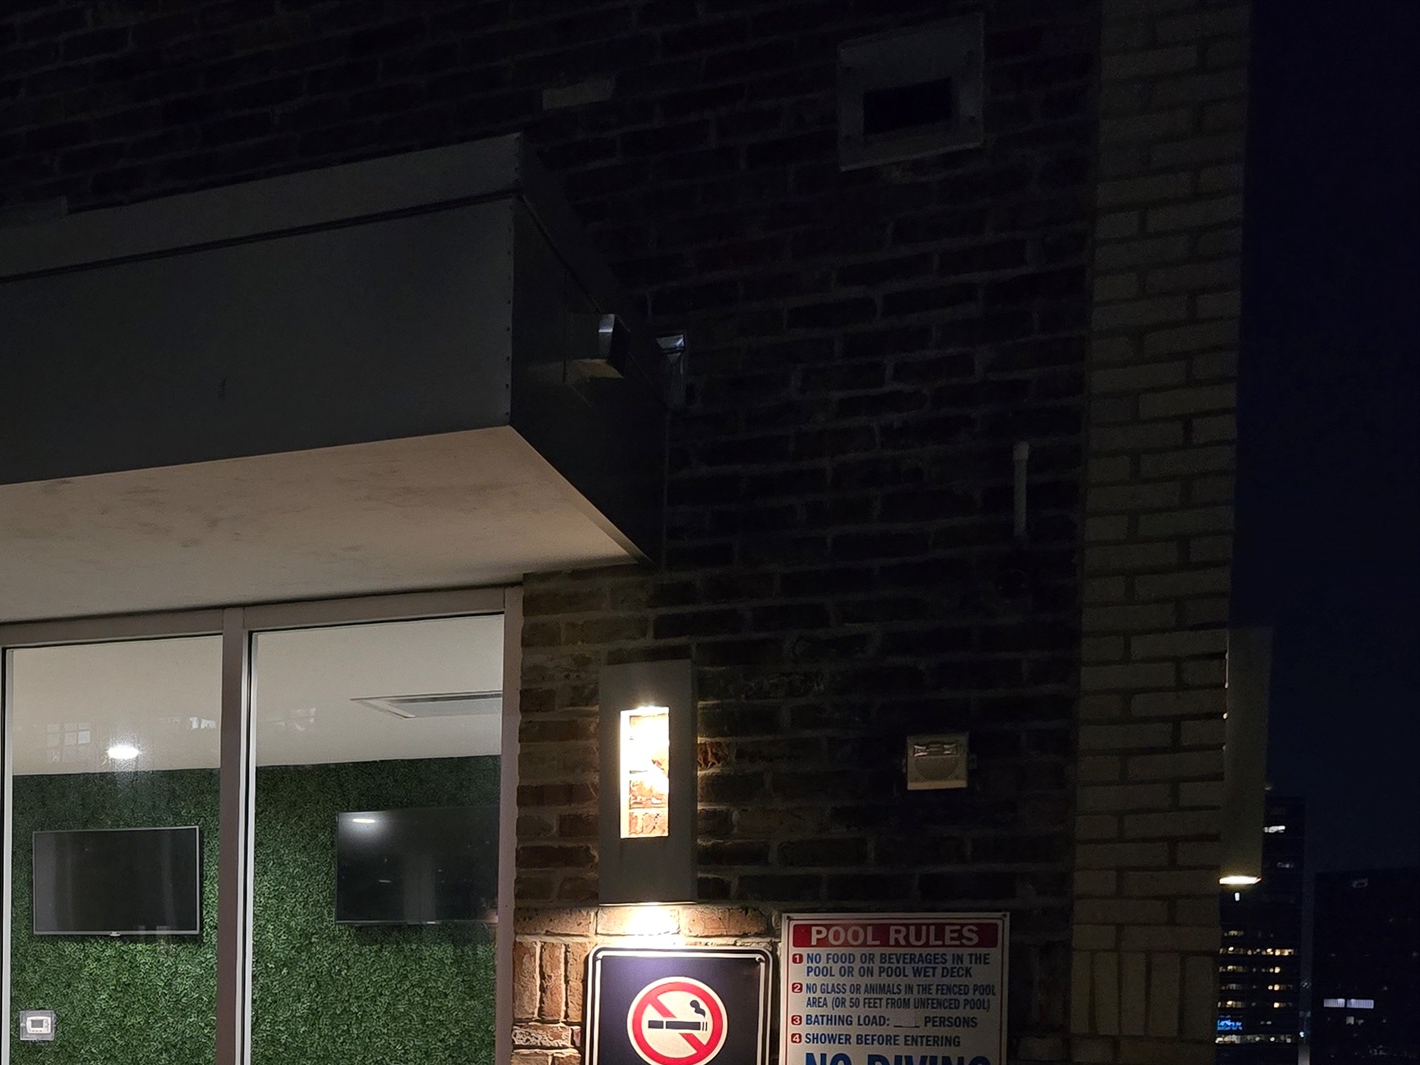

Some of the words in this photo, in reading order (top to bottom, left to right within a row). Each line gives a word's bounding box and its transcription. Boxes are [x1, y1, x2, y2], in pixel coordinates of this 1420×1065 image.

[810, 926, 880, 945] POOL
[889, 925, 979, 946] RULES
[794, 954, 801, 963] 1
[807, 954, 821, 964] NO
[826, 954, 855, 964] FOOD
[860, 954, 875, 964] OR
[880, 953, 947, 964] BEVERAGES
[952, 954, 964, 964] IN
[968, 953, 990, 964] THE
[807, 967, 834, 977] POOL
[839, 967, 854, 977] OR
[859, 967, 874, 977] ON
[879, 967, 908, 977] POOL
[913, 967, 937, 977] WET
[941, 967, 972, 977] DECK
[793, 984, 801, 993] 2
[806, 984, 817, 994] NO
[820, 984, 846, 994] GLASS
[849, 984, 861, 994] OR
[864, 984, 901, 994] ANIMALS
[905, 985, 913, 994] IN
[917, 985, 932, 995] THE
[935, 984, 969, 995] FENCED
[973, 985, 996, 995] POOL
[806, 998, 828, 1008] AREA
[832, 998, 846, 1010] (OR
[849, 998, 859, 1008] 50
[863, 998, 883, 1009] FEET
[886, 998, 910, 1009] FROM
[914, 999, 960, 1009] UNFENCED
[963, 999, 990, 1011] POOL)
[792, 1016, 800, 1025] 3
[806, 1015, 852, 1026] BATHING
[857, 1016, 890, 1026] LOAD:
[924, 1017, 977, 1027] PERSONS
[792, 1034, 800, 1043] 4
[805, 1034, 851, 1045] SHOWER
[856, 1035, 899, 1046] BEFORE
[904, 1036, 960, 1047] ENTERING
